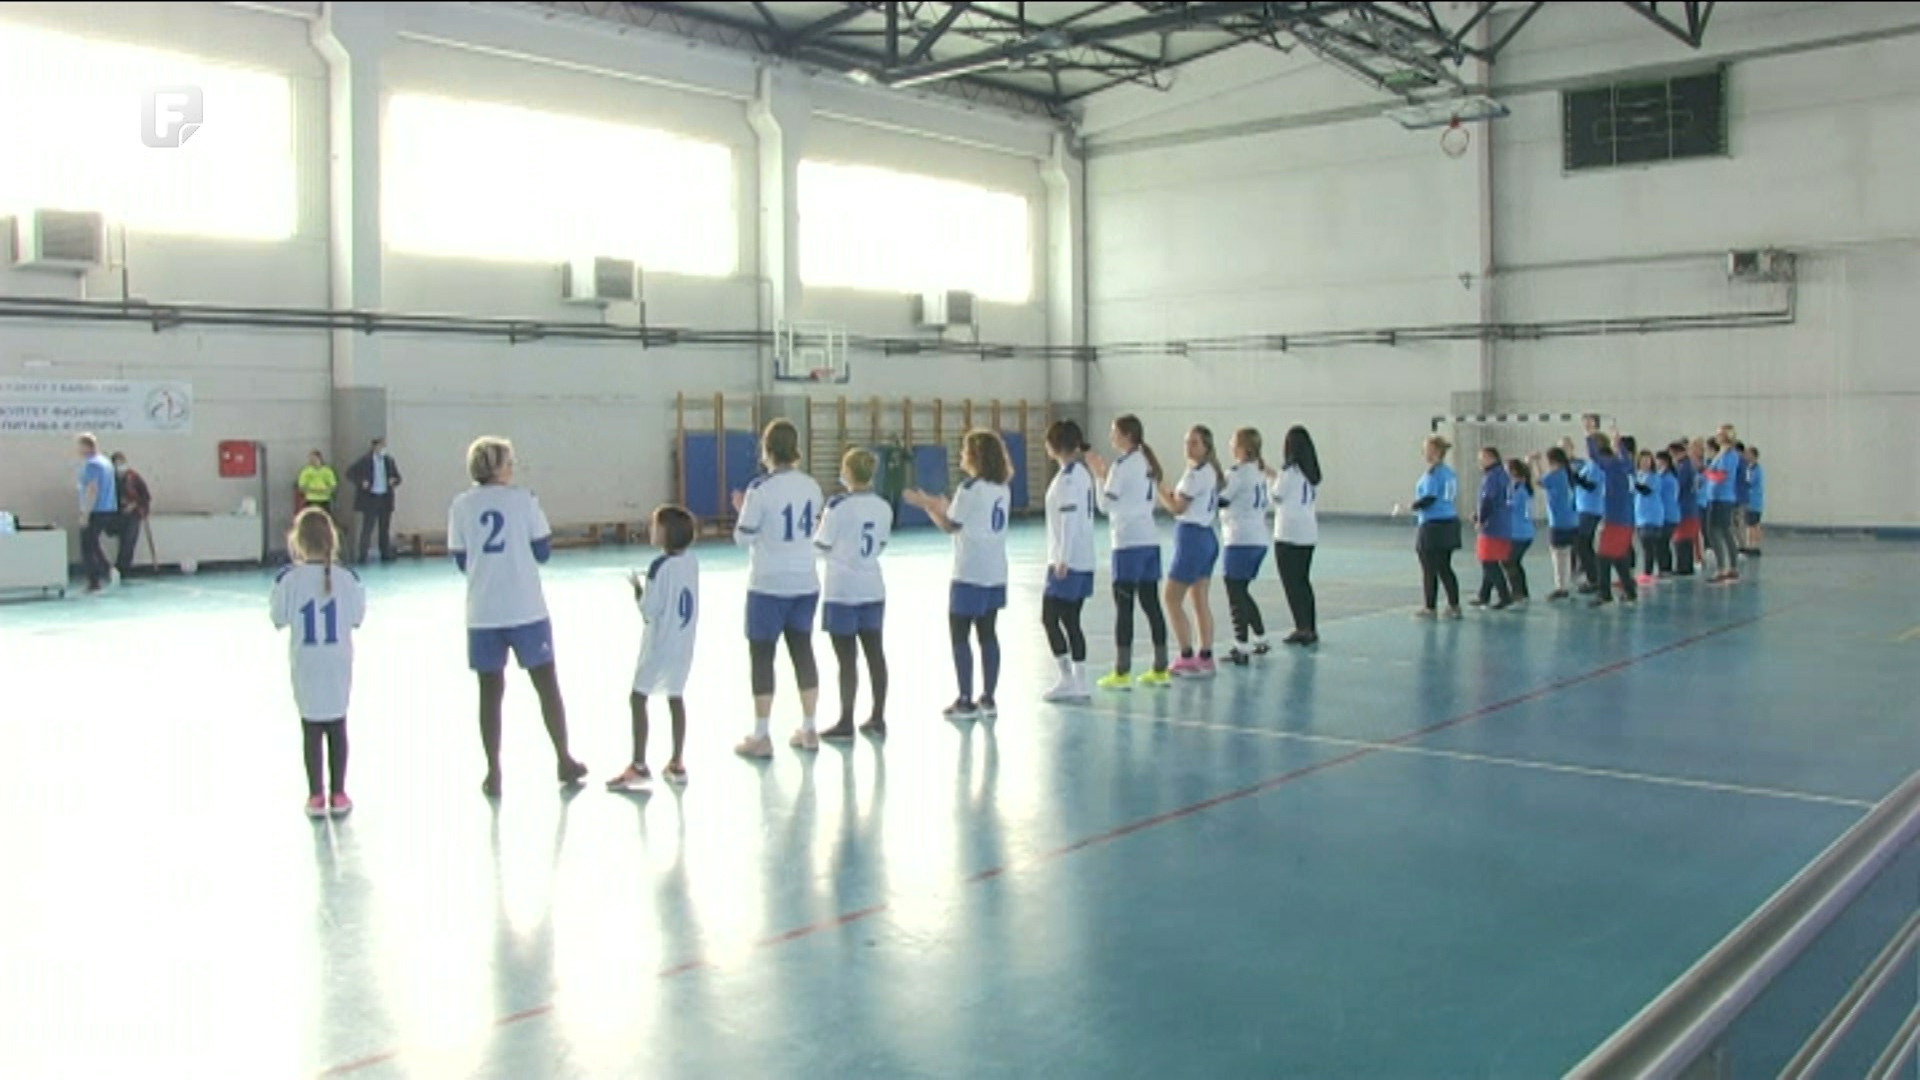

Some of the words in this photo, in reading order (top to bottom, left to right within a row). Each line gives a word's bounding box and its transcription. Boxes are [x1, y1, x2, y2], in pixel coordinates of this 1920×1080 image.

[479, 510, 506, 554] 2
[781, 499, 814, 542] 14
[991, 495, 1005, 534] 6
[860, 521, 875, 558] 5
[299, 598, 339, 645] 11
[679, 587, 693, 630] 9
